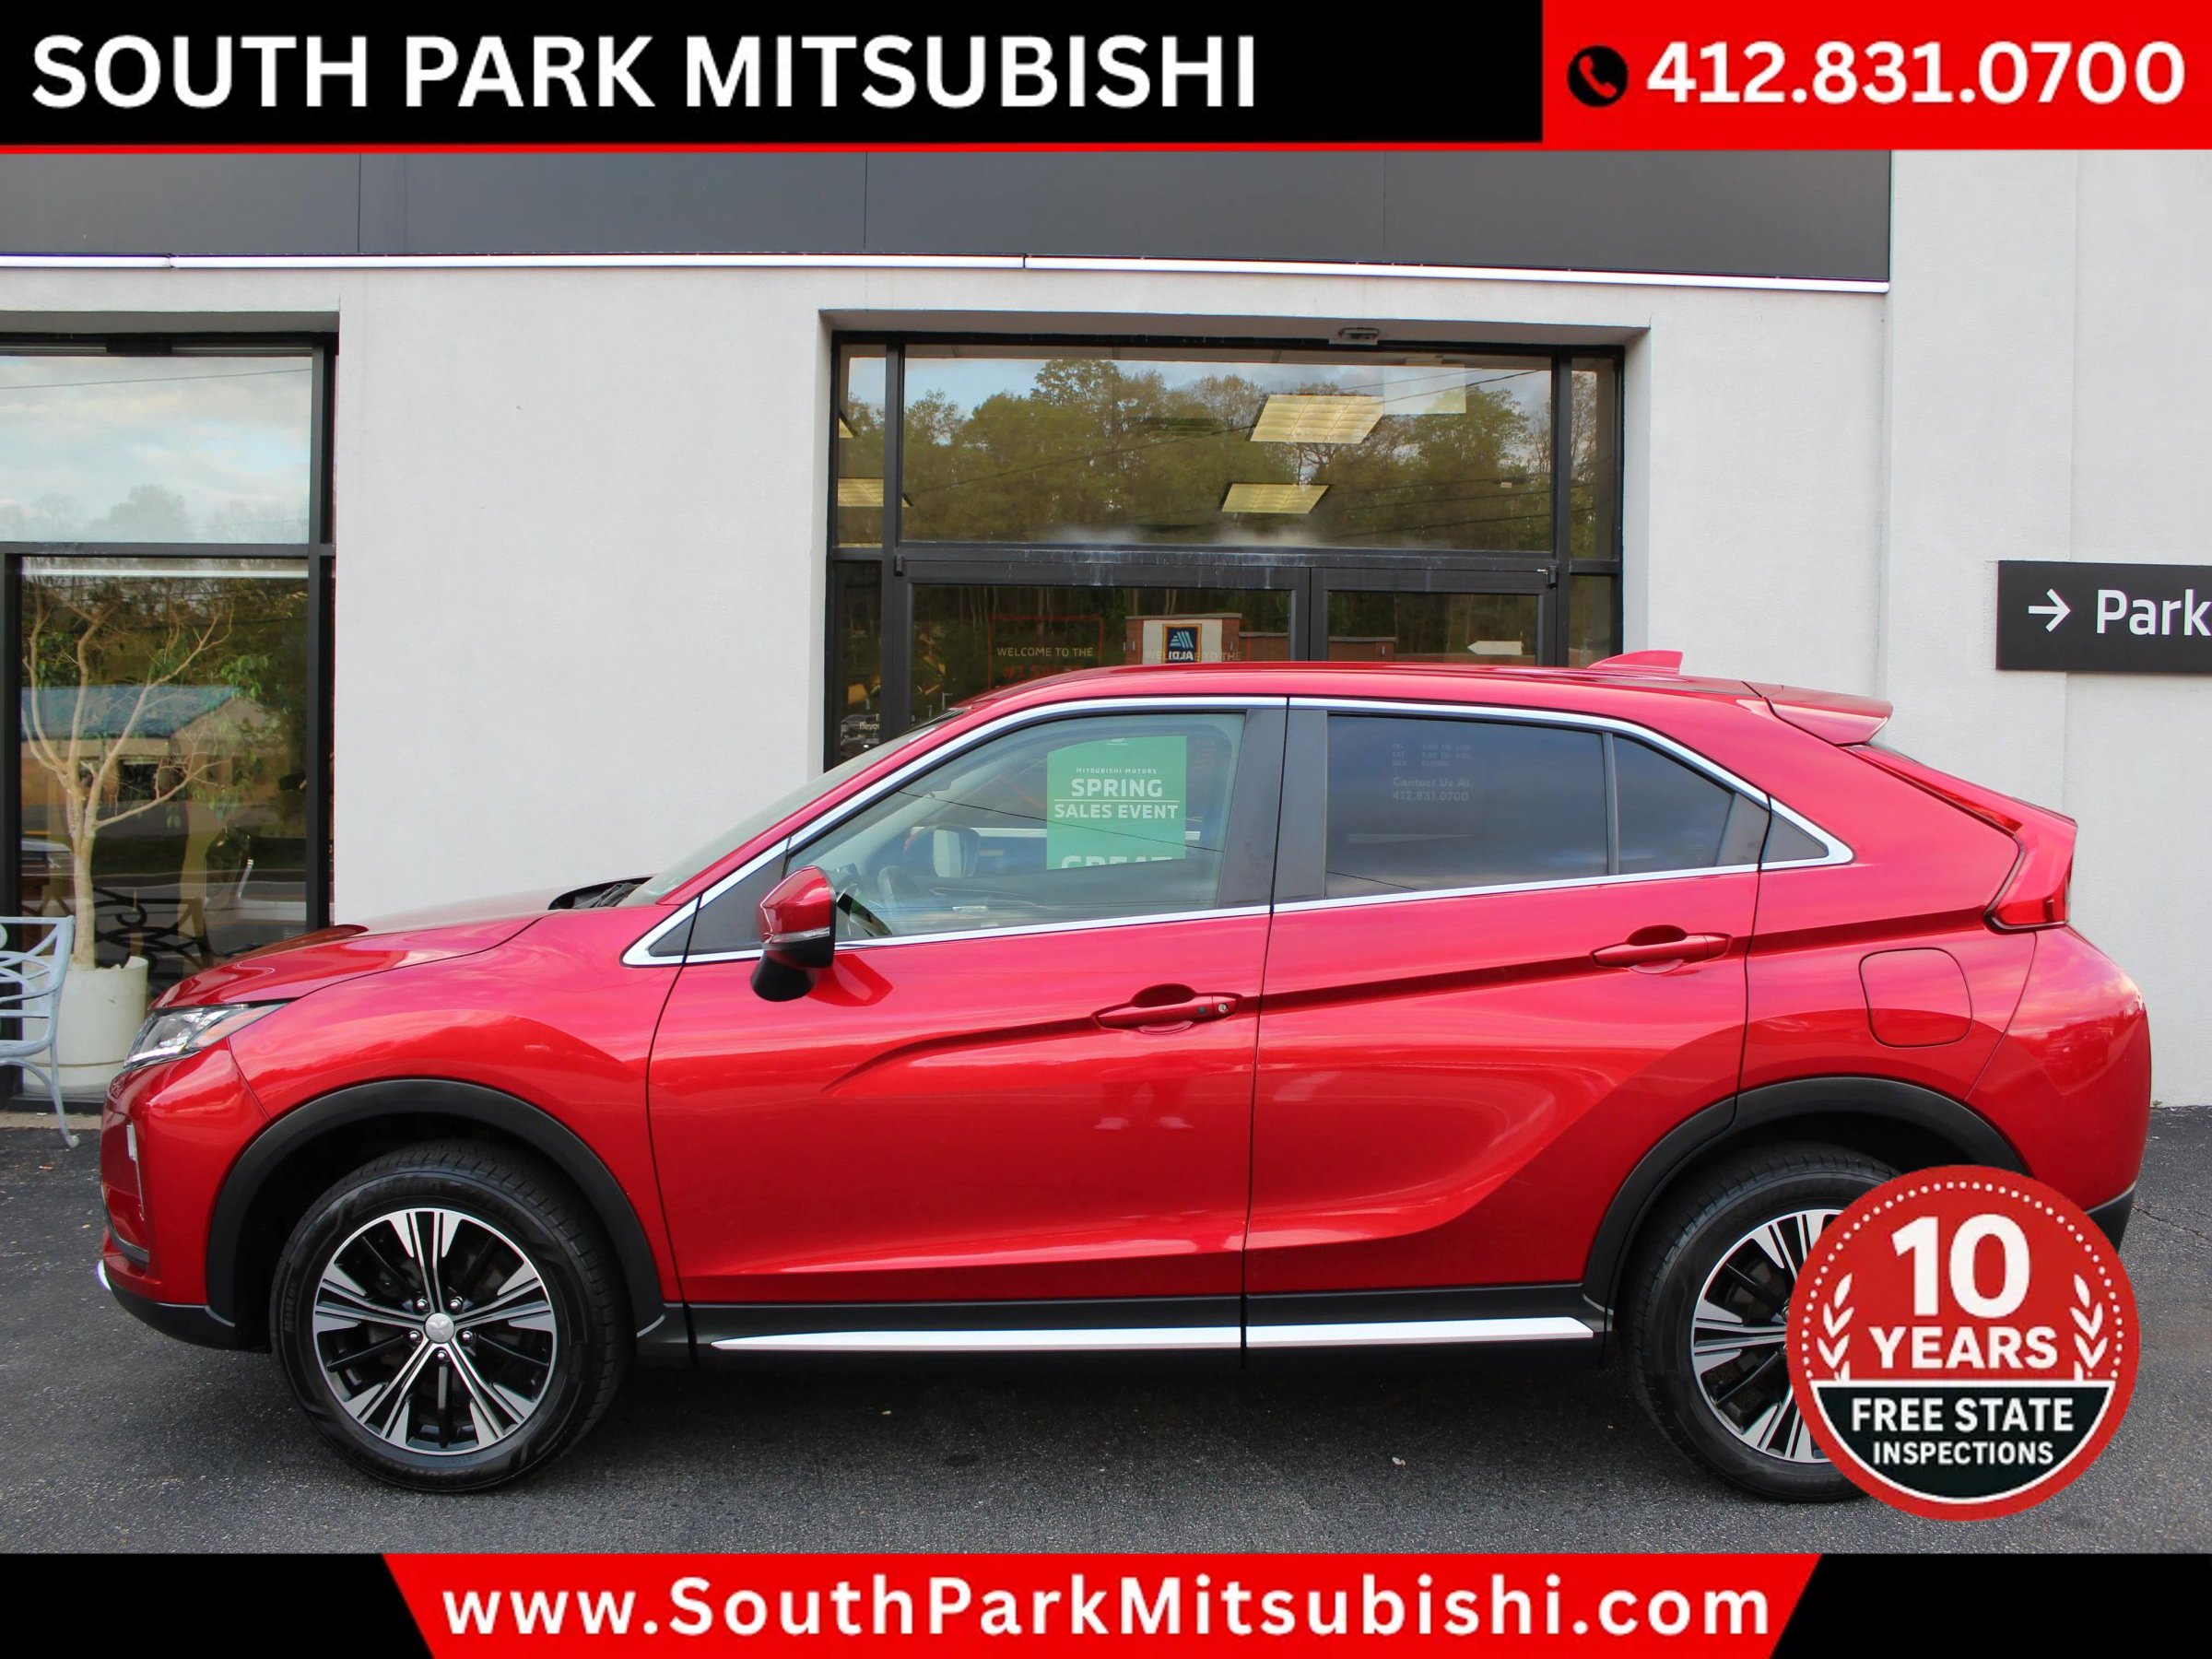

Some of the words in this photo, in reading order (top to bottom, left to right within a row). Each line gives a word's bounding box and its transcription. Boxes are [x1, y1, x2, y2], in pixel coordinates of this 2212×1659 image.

[2097, 588, 2212, 636] Park
[997, 647, 1052, 657] WELCOME
[1054, 647, 1069, 657] TO
[1073, 647, 1094, 657] THE
[1071, 778, 1163, 797] SPRING
[1393, 776, 1436, 787] Contact
[1440, 777, 1453, 787] Us
[1456, 777, 1470, 787] At
[1392, 790, 1469, 801] 412.831.0700
[1054, 804, 1112, 818] SALES
[1118, 805, 1179, 819] EVENT
